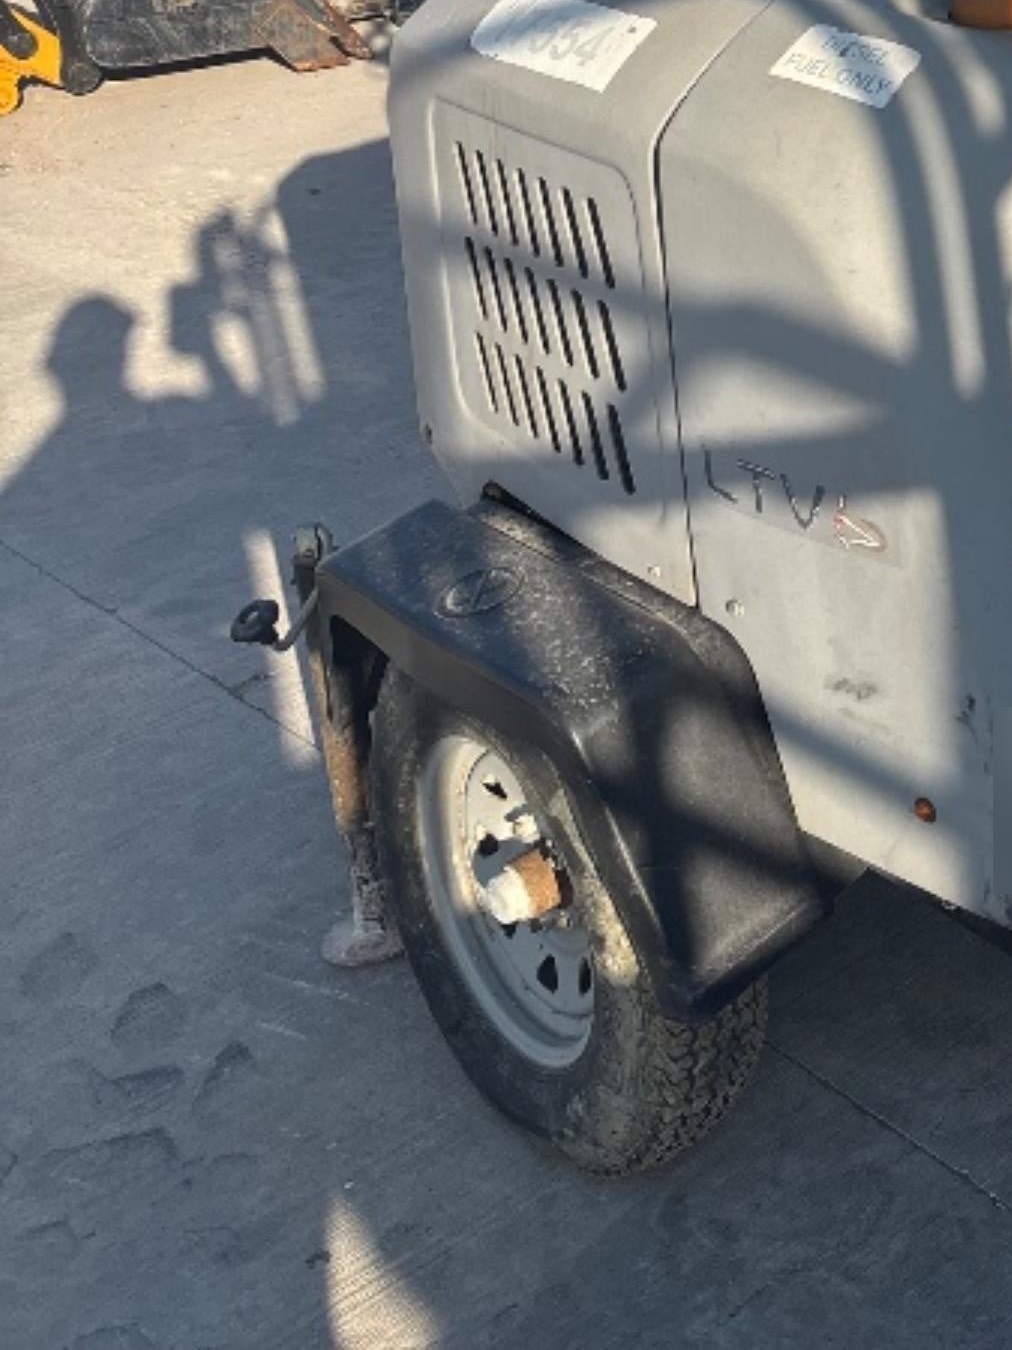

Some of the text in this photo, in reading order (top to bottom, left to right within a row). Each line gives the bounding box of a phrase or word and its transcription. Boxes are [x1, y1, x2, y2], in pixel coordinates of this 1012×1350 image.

[820, 34, 890, 67] DIESEL
[783, 52, 894, 95] FUEL ONLY
